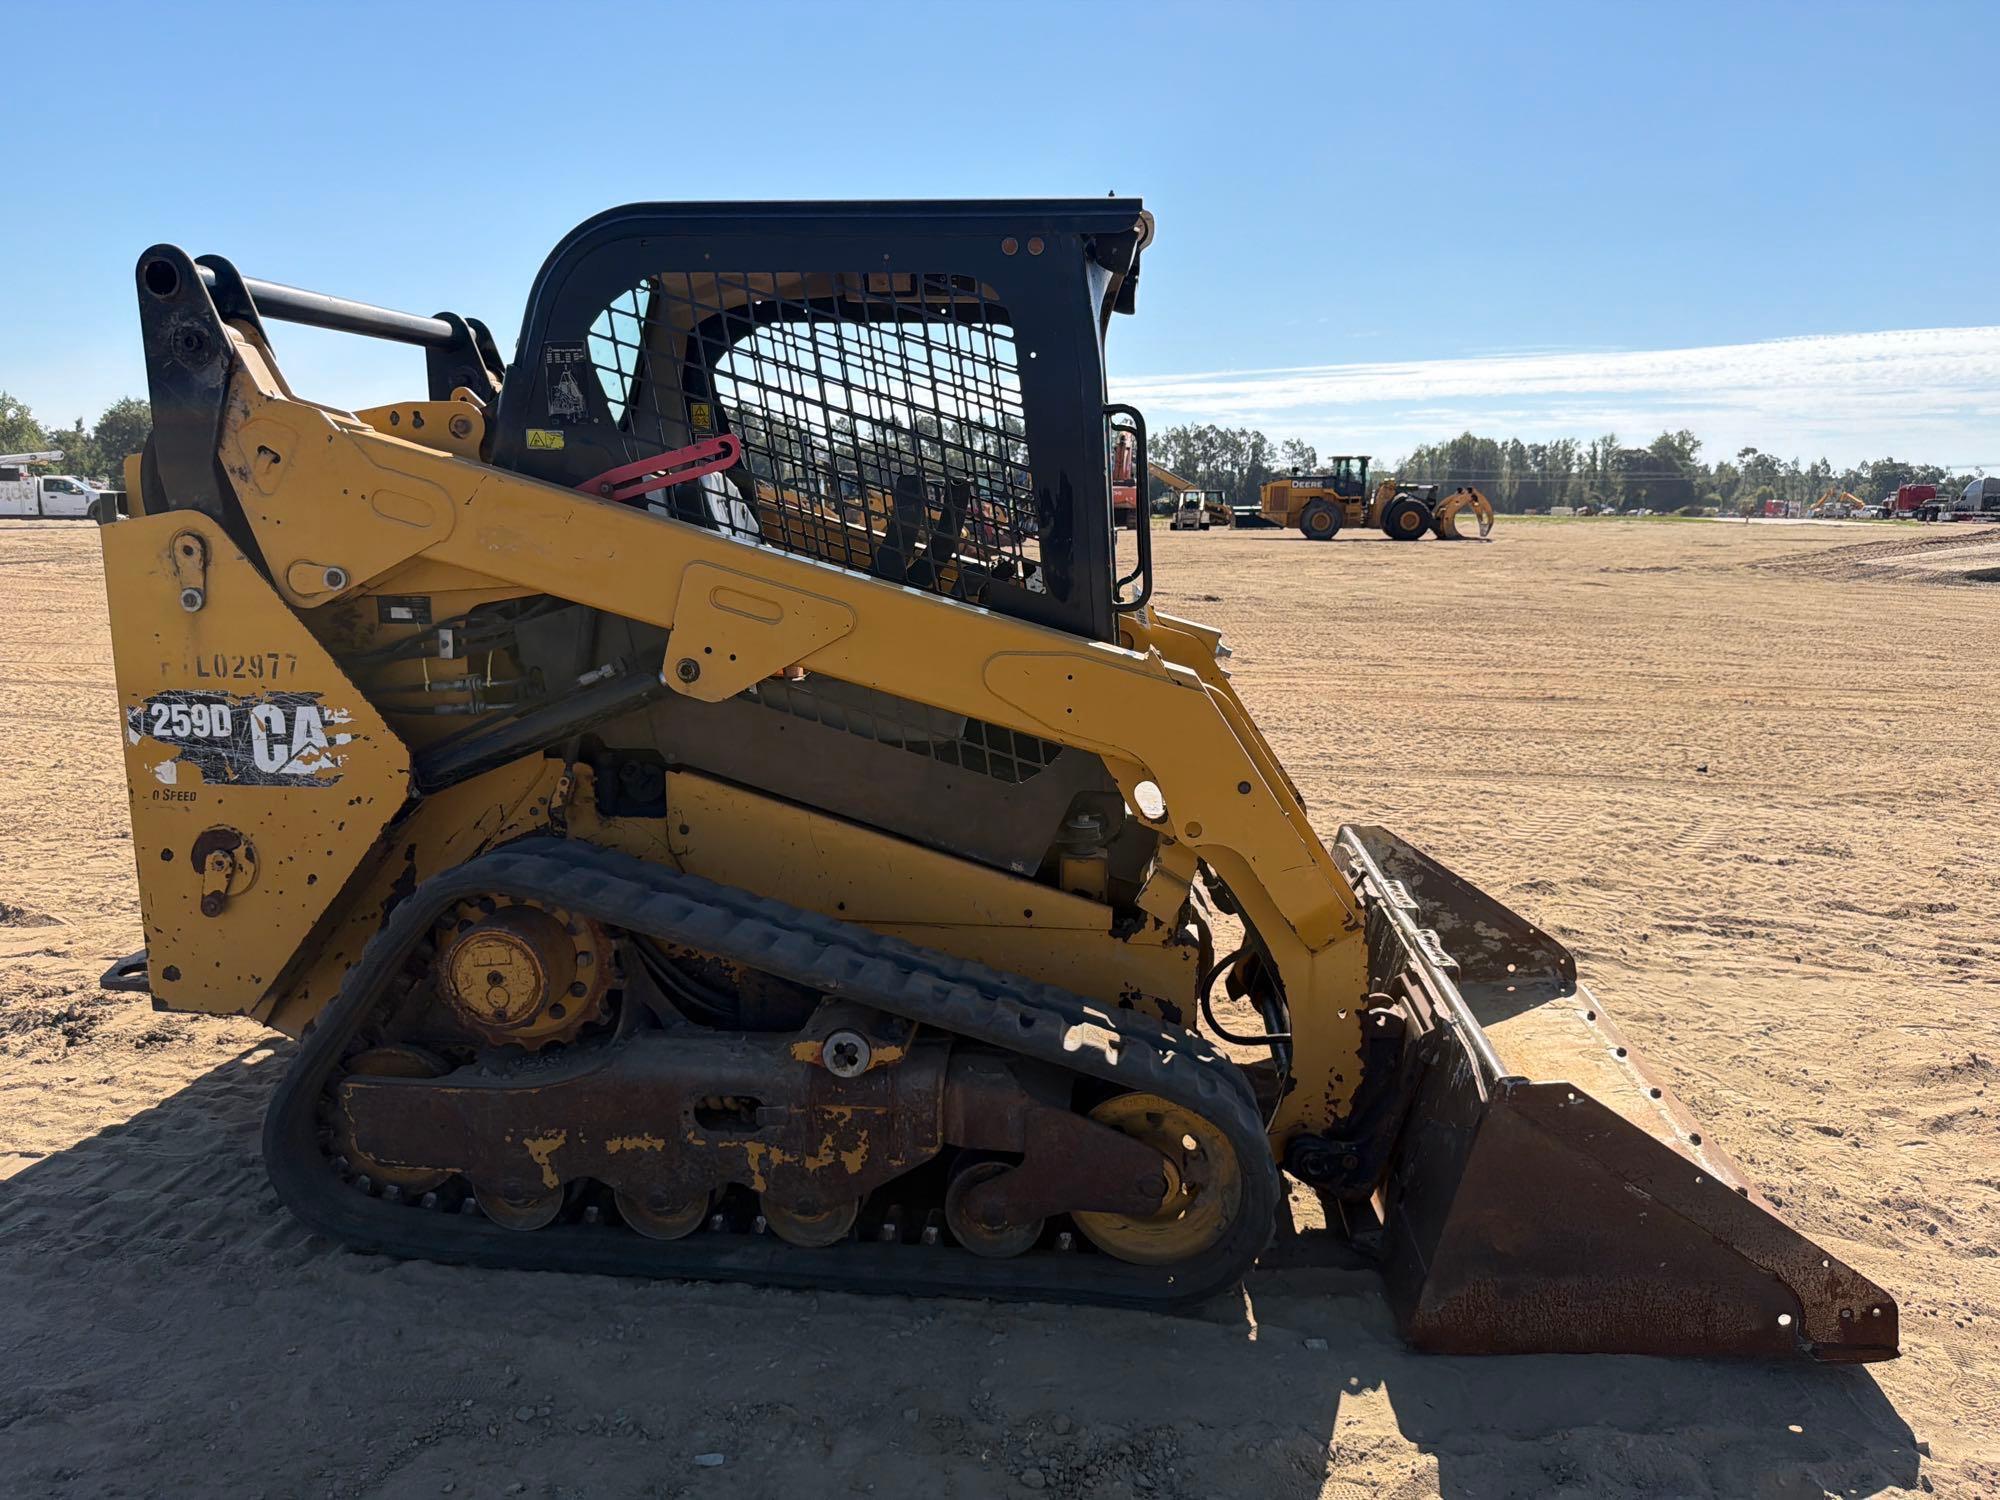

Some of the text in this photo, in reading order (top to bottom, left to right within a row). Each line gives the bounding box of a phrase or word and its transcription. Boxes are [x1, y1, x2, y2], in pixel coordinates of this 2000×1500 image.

[1291, 480, 1323, 488] DEERE
[150, 703, 232, 738] 259D
[250, 703, 352, 774] CA
